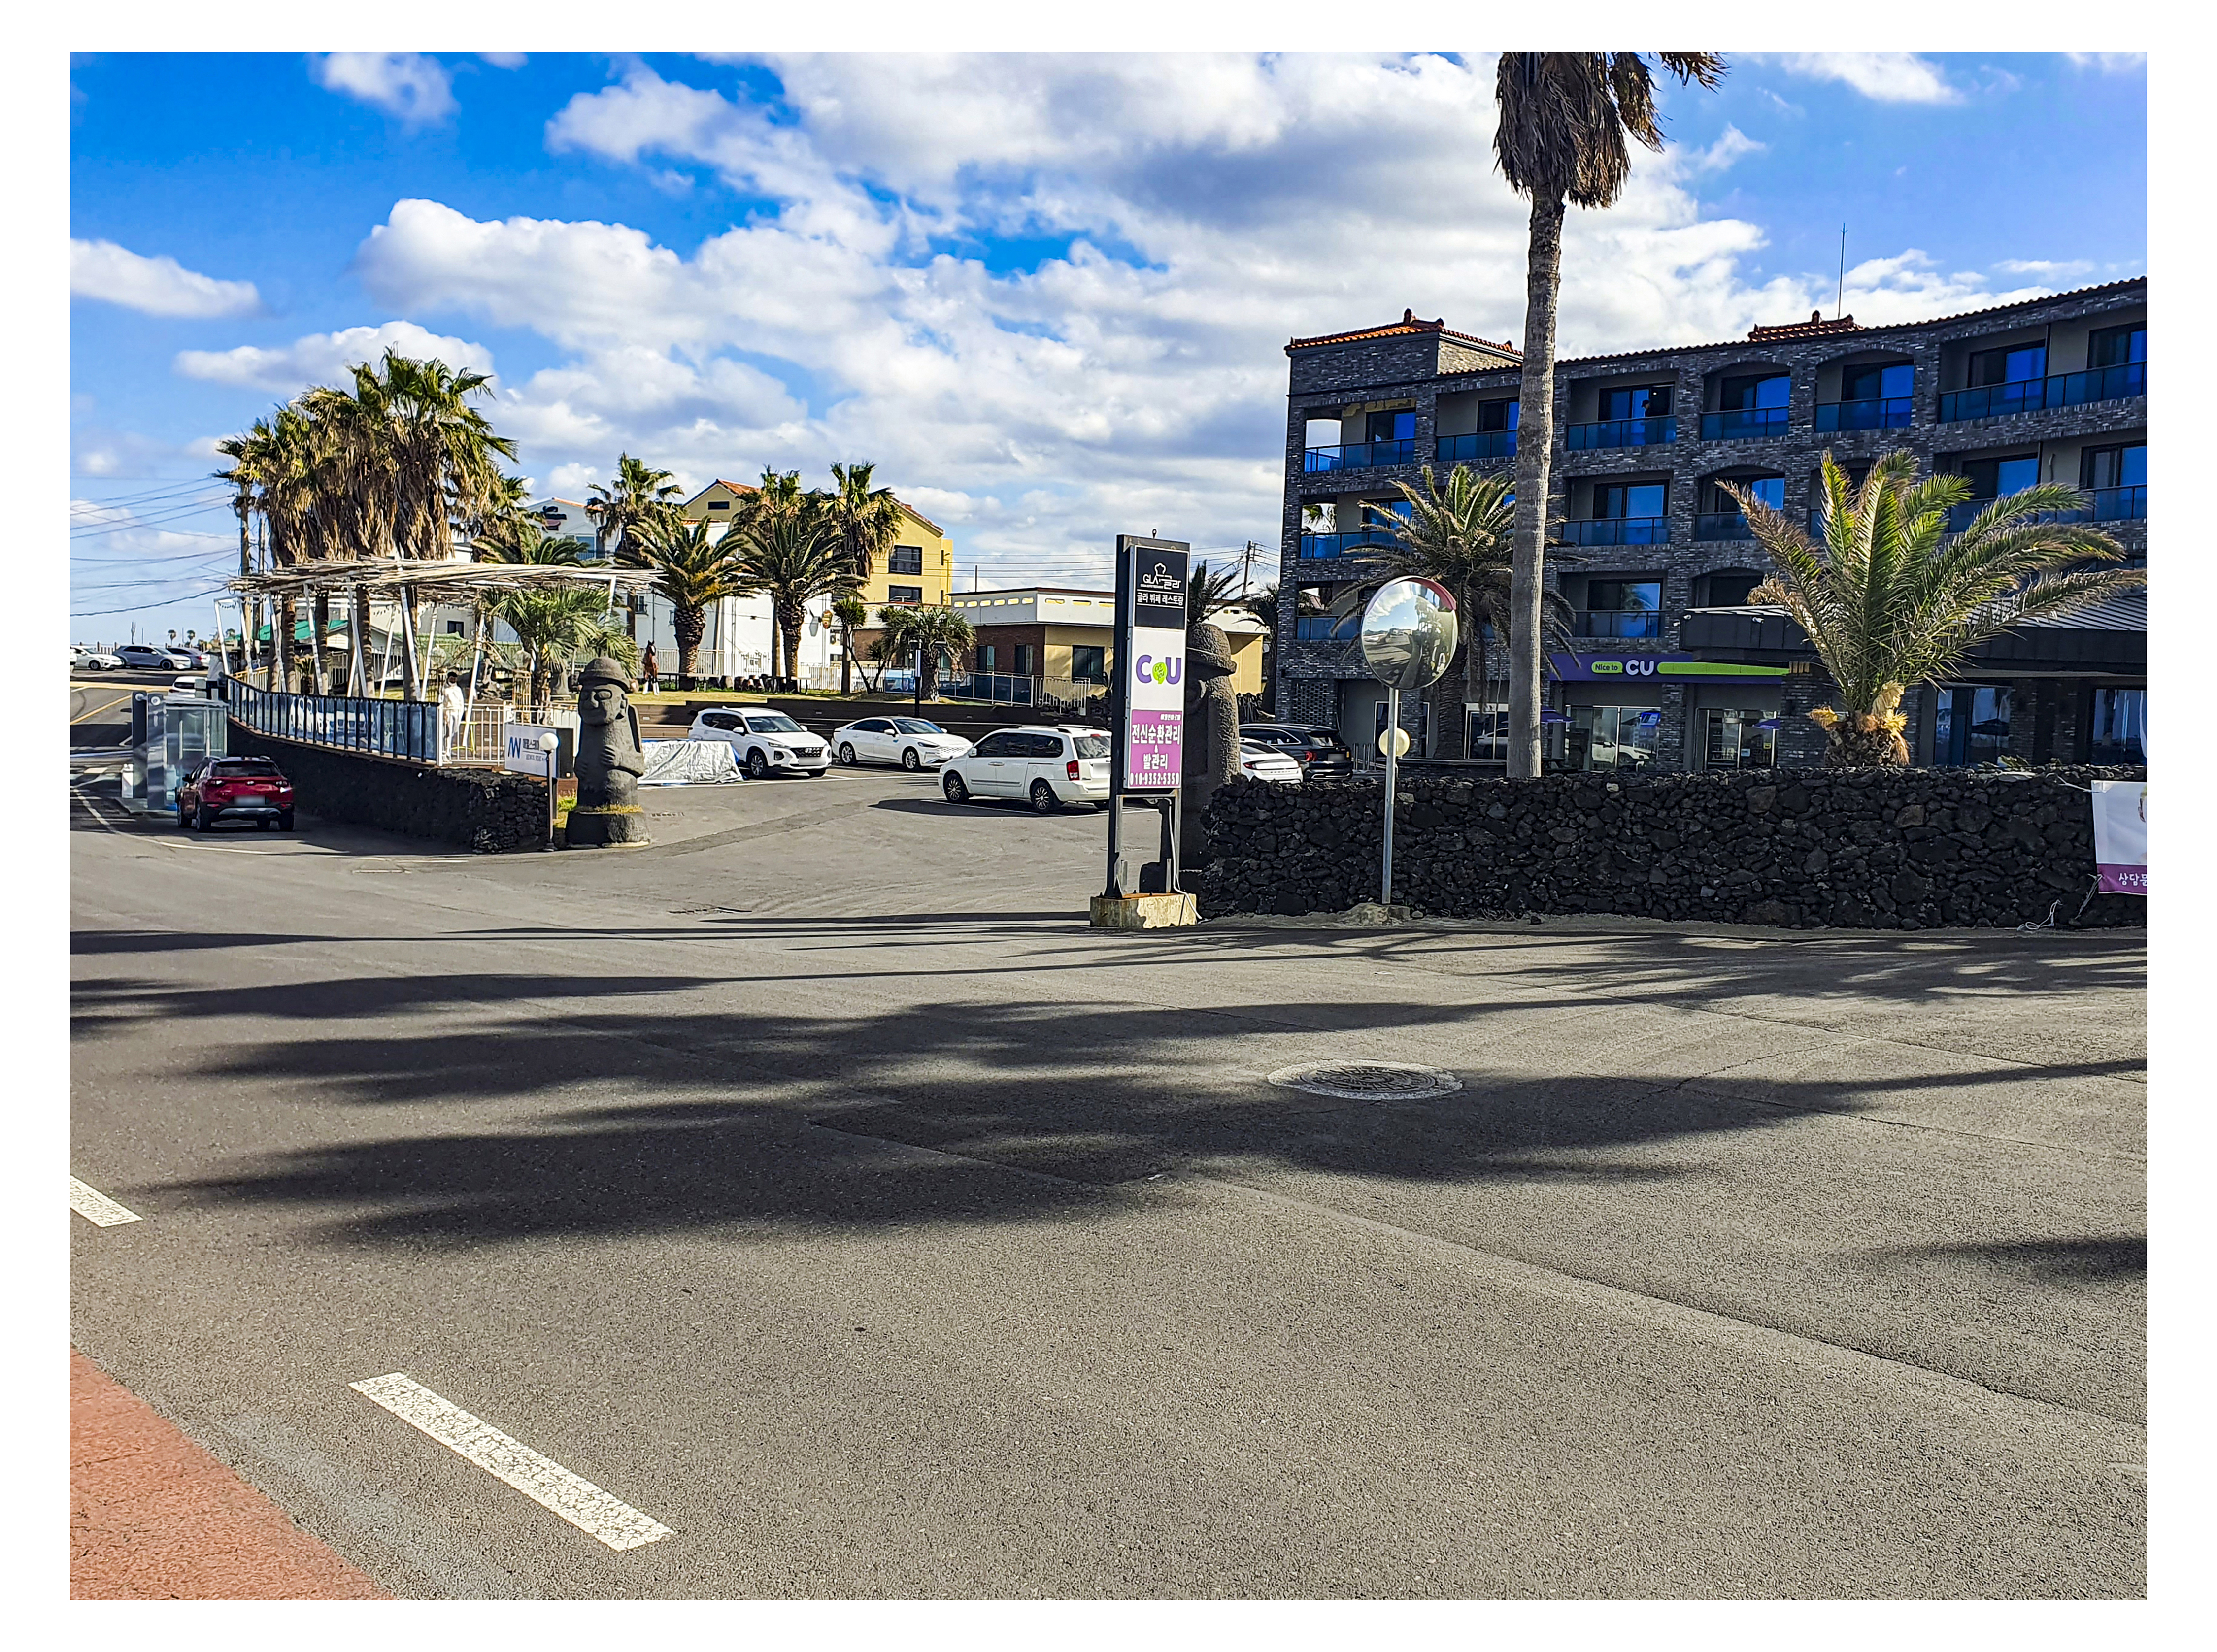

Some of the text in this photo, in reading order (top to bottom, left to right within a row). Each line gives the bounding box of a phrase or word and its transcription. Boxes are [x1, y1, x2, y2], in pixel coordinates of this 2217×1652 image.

[1137, 592, 1184, 606] 글라 뷔페 레스토랑
[1626, 660, 1654, 676] CU
[1132, 723, 1181, 745] 전신순환관리
[1143, 753, 1168, 770] 발관리
